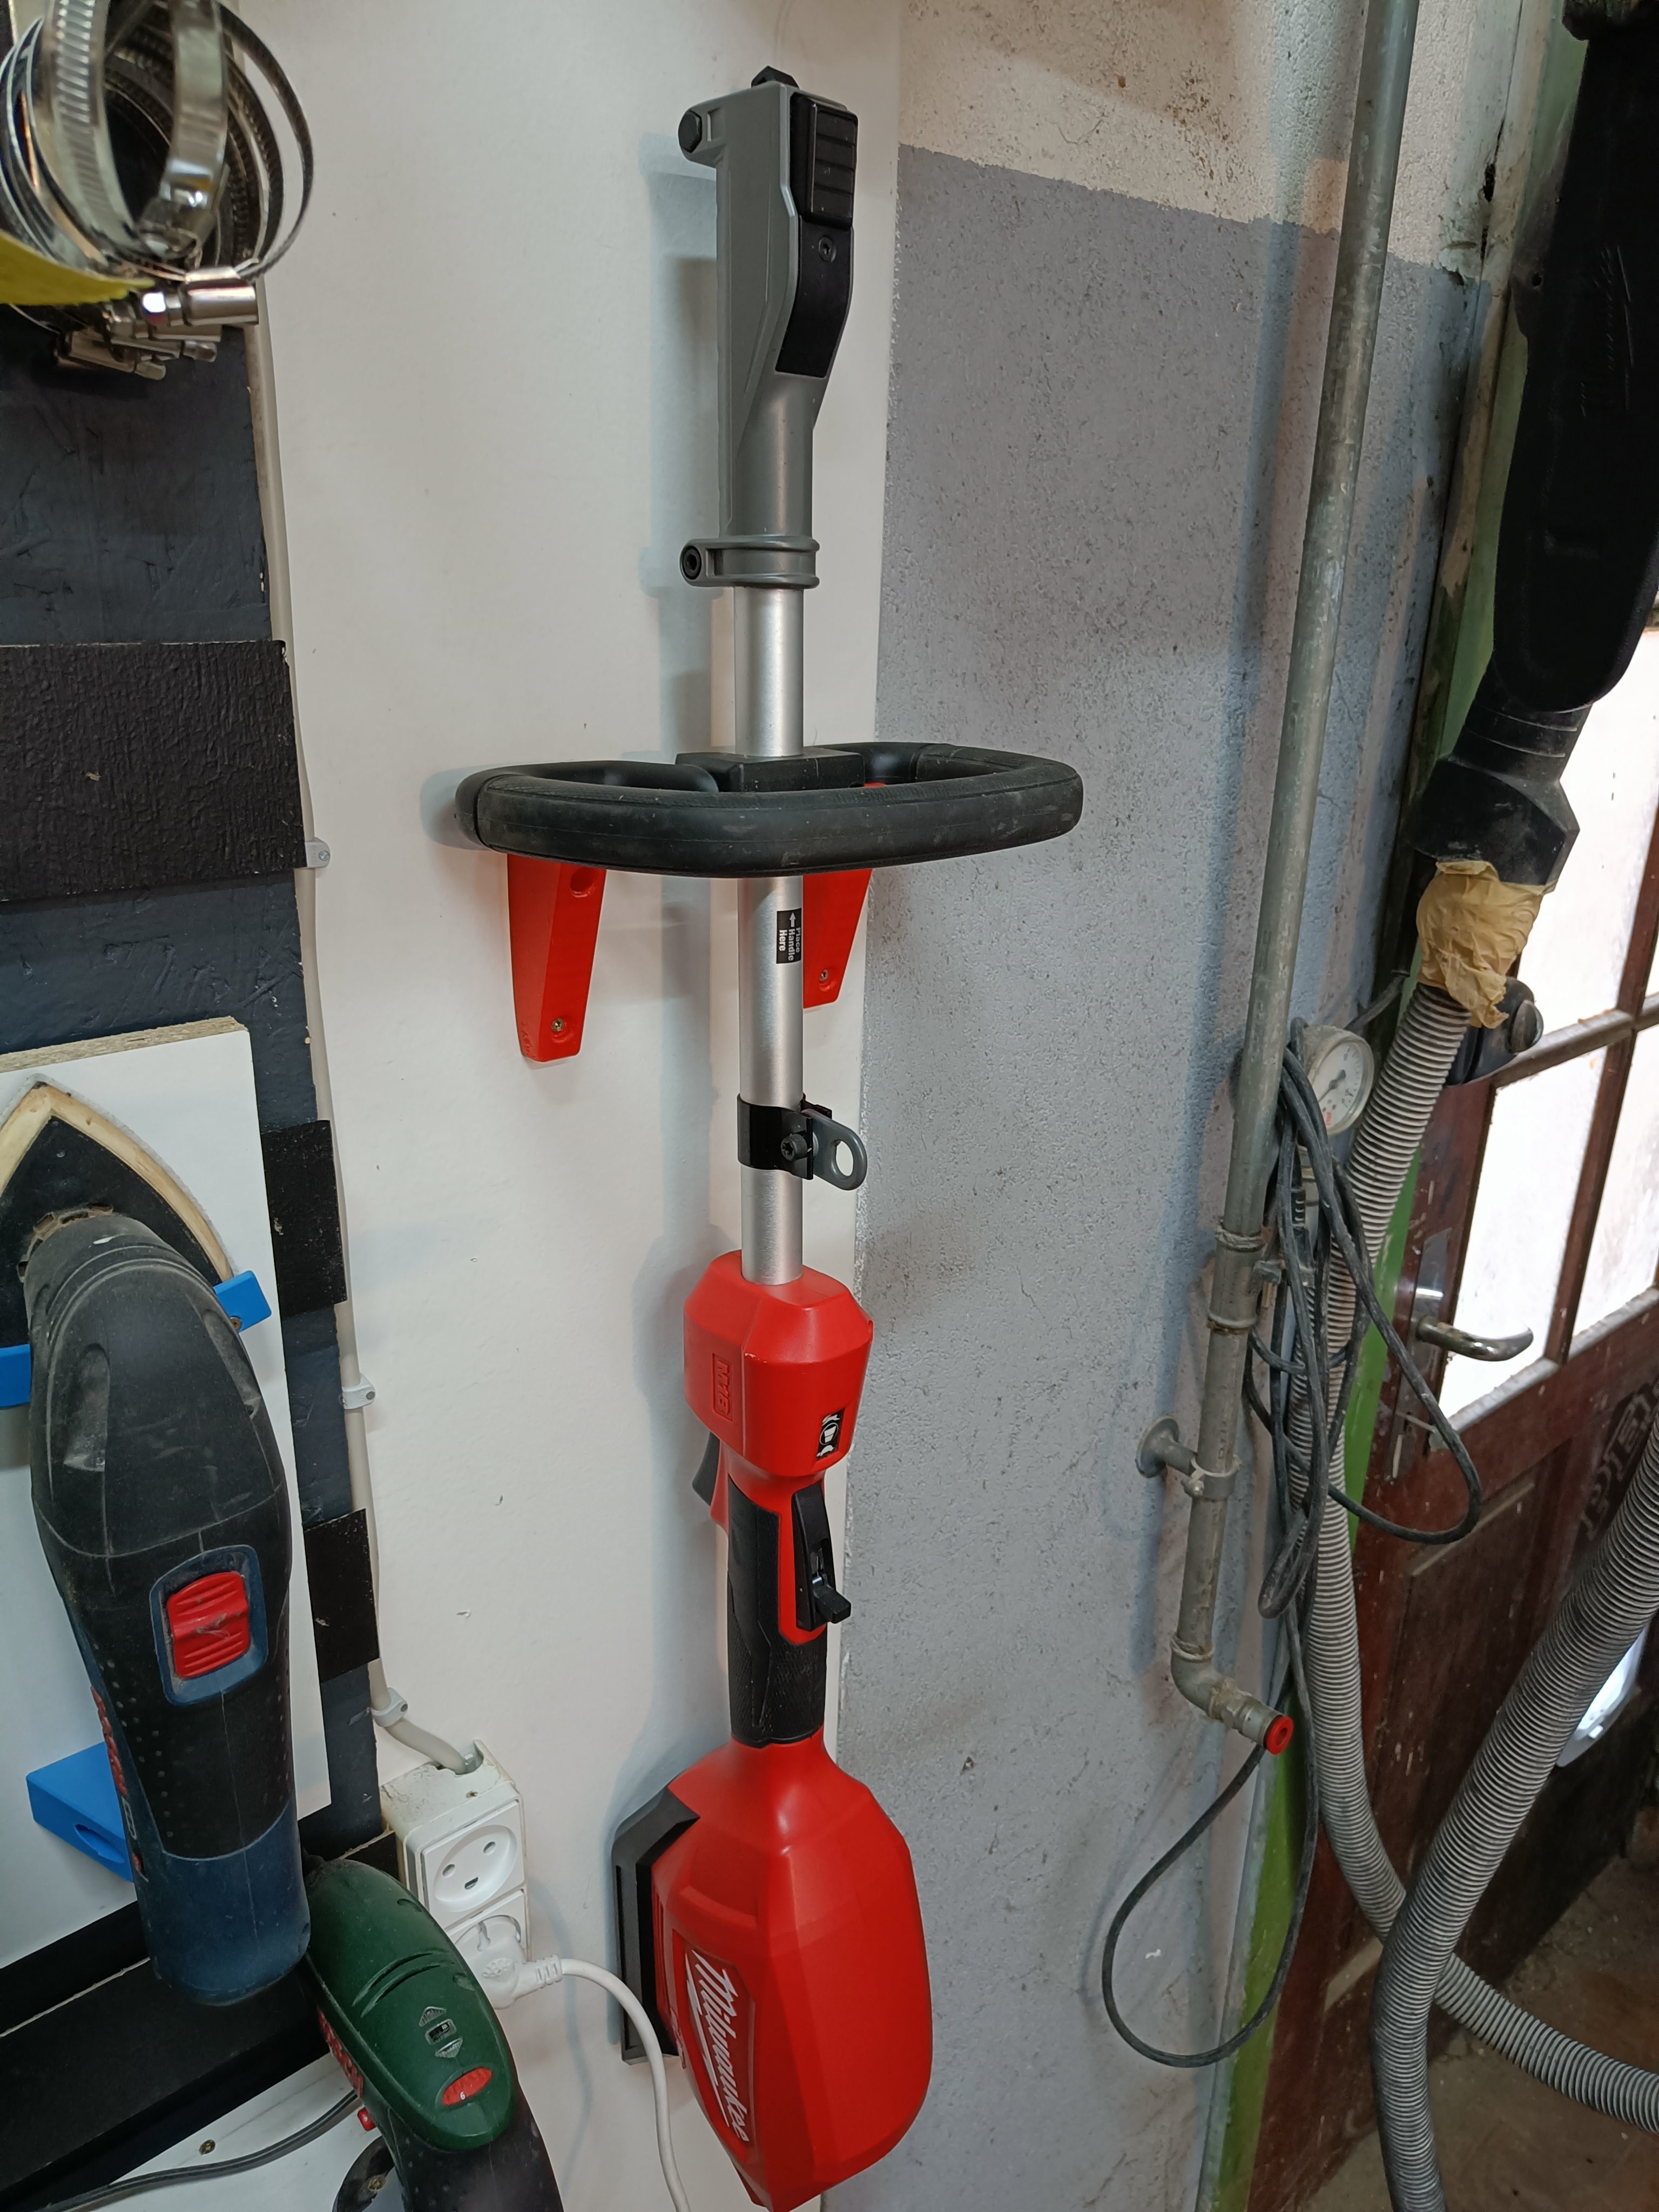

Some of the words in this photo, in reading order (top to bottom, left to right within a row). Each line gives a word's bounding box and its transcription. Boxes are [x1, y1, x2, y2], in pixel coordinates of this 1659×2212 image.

[779, 929, 787, 951] Here
[717, 1360, 730, 1415] M18
[691, 1949, 750, 2142] Milwaukee
